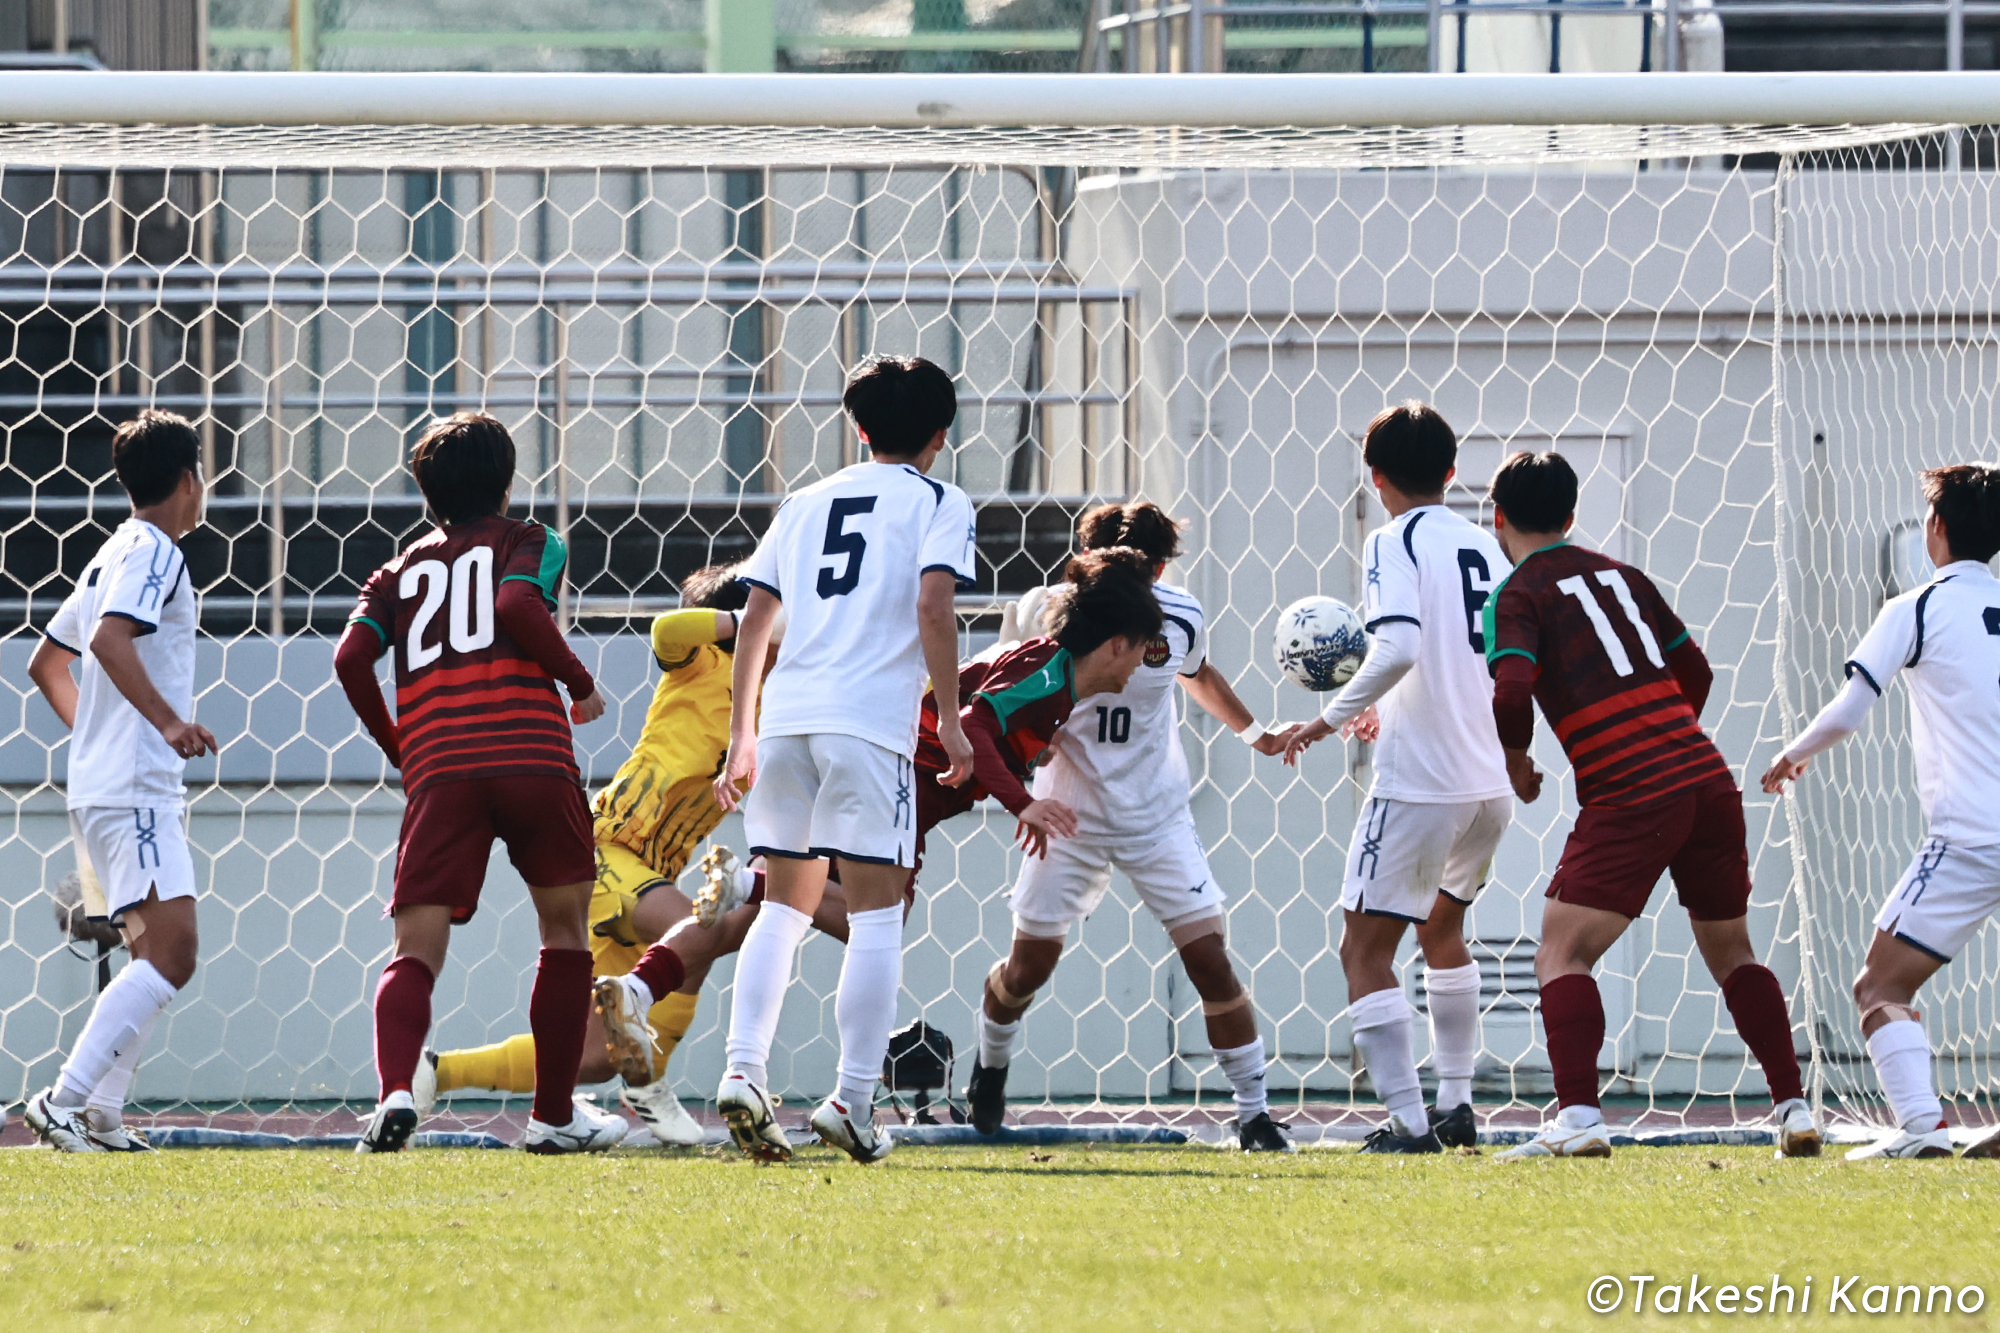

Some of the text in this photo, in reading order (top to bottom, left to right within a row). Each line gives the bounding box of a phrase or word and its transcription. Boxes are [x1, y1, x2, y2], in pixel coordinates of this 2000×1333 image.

[816, 495, 878, 600] 5
[398, 546, 494, 673] 20
[1457, 548, 1490, 654] 6
[1556, 569, 1666, 677] 11
[1096, 706, 1131, 743] 10
